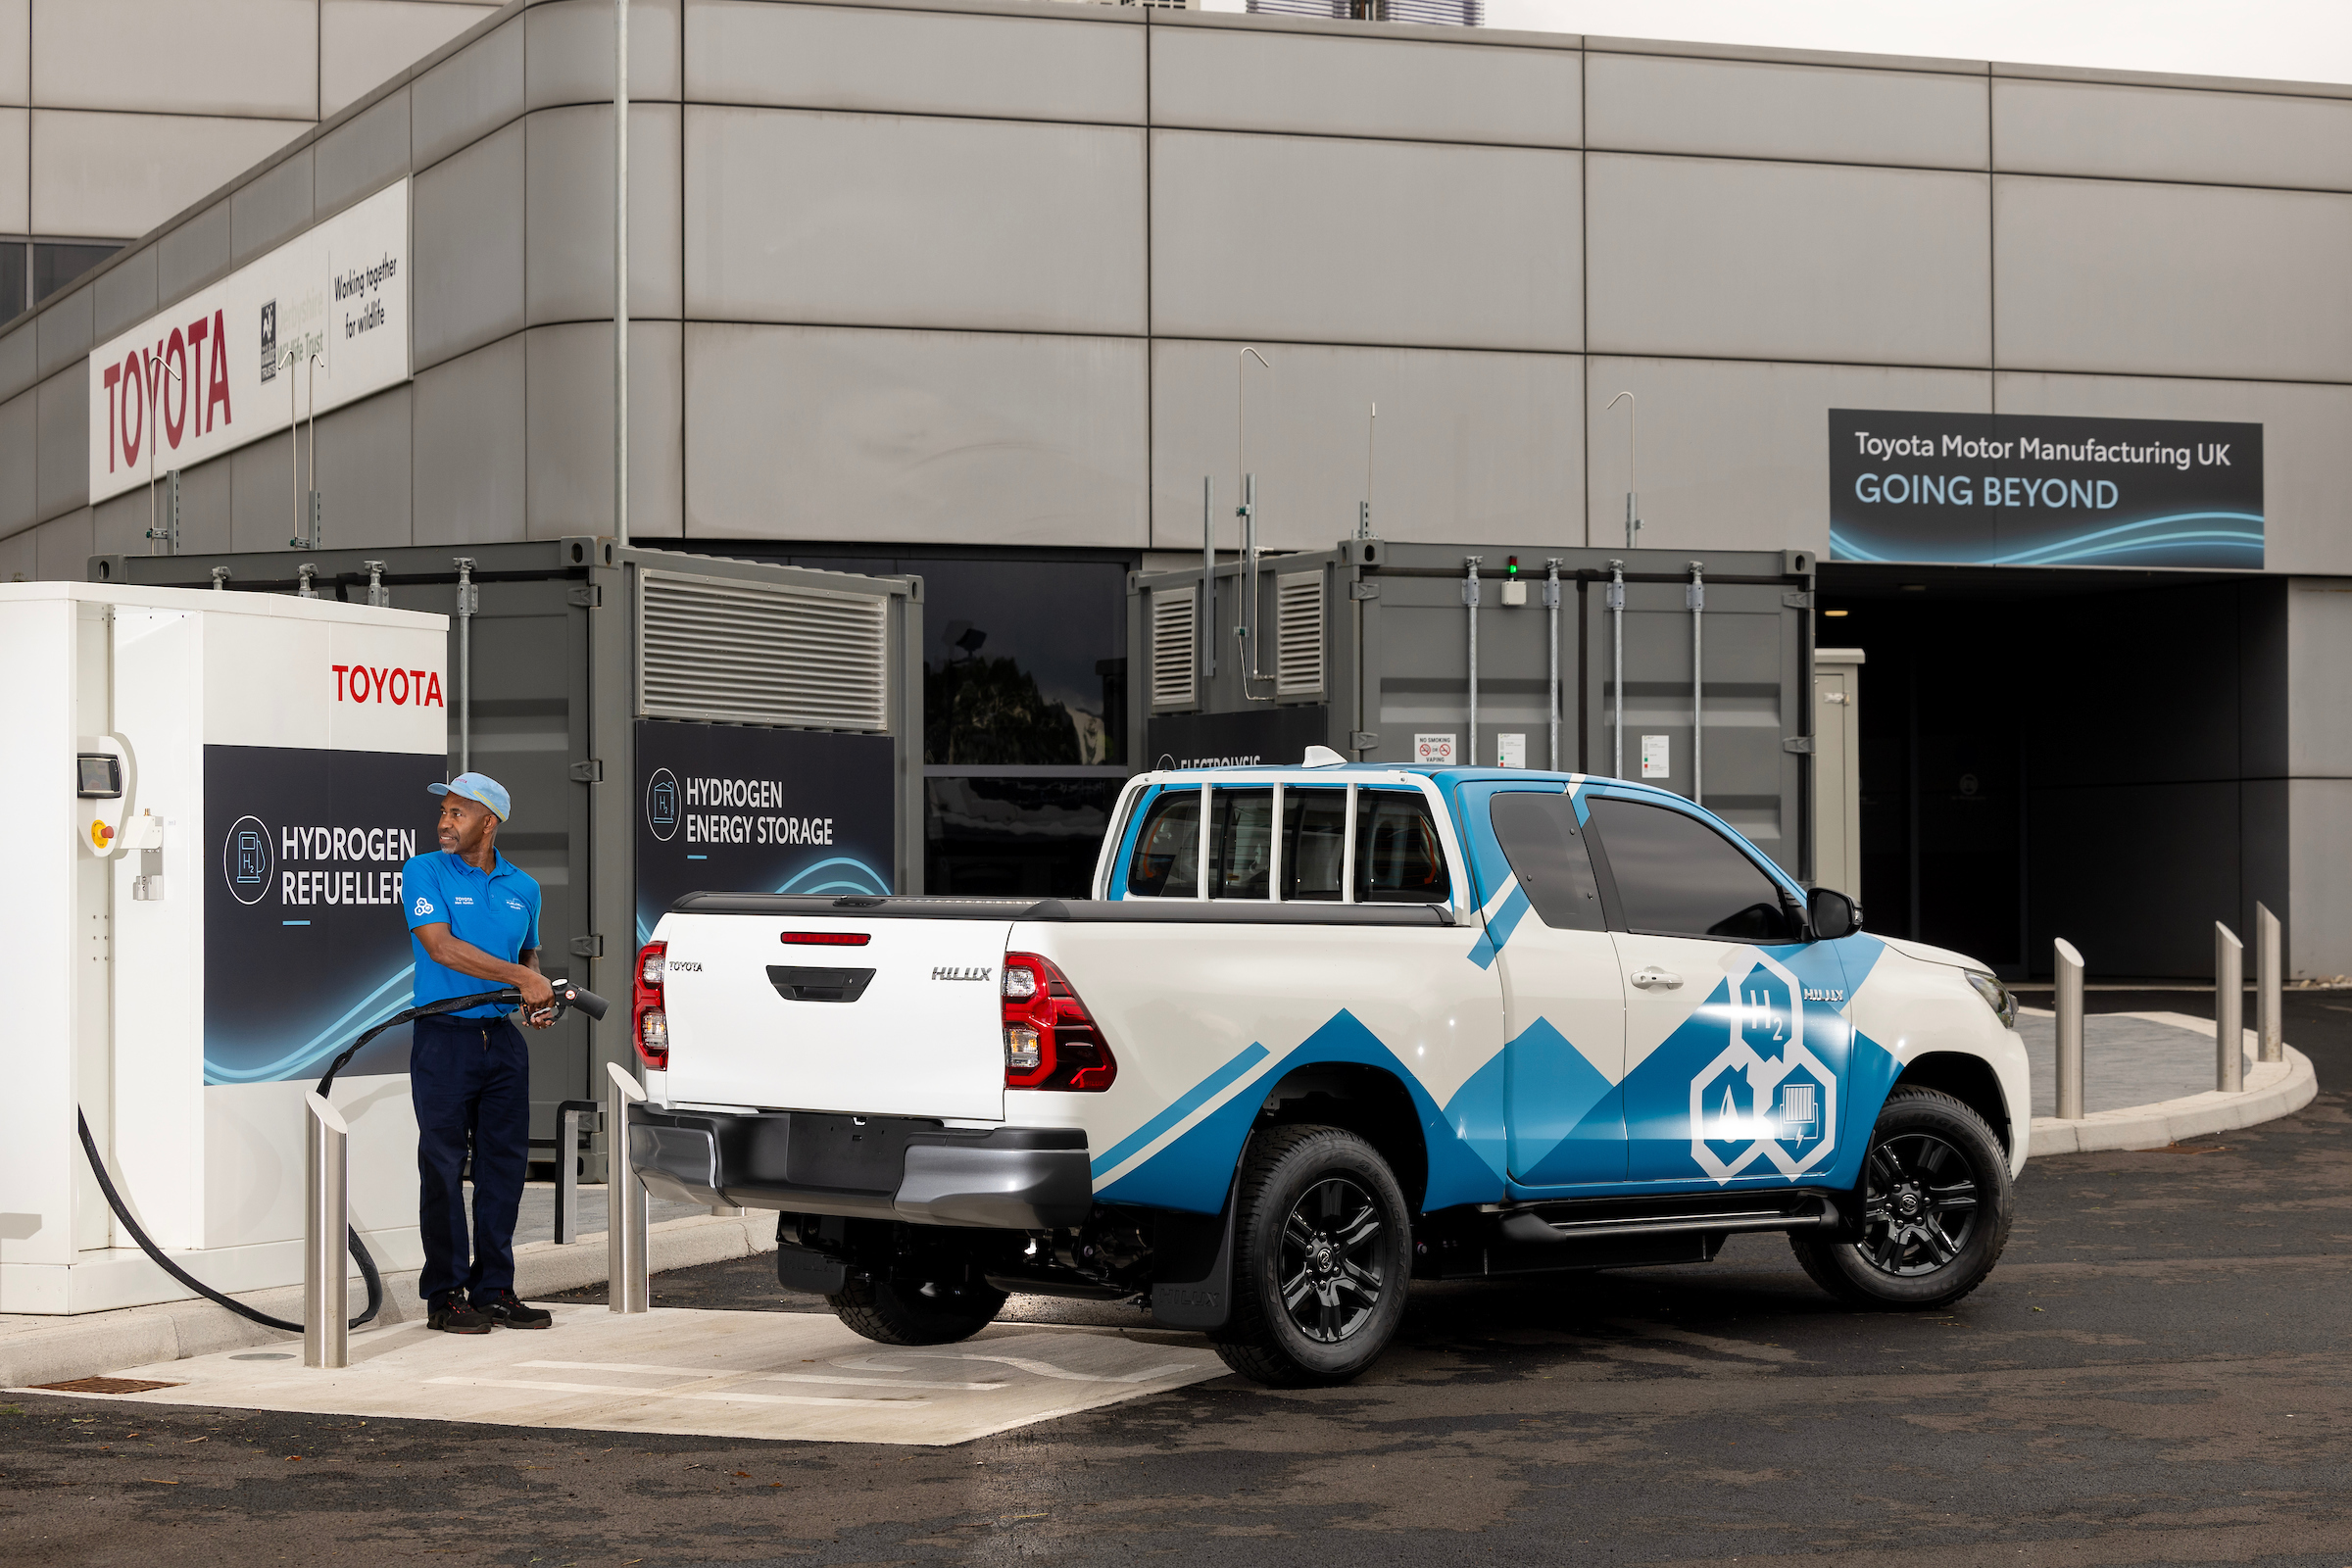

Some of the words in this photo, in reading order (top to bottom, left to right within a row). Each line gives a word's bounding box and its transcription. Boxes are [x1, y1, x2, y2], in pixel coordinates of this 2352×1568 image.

[334, 270, 364, 302] Working
[367, 252, 397, 291] together
[346, 313, 356, 340] for
[358, 298, 385, 334] wildlife
[305, 329, 323, 359] Trust
[104, 309, 231, 473] TOYOTA
[1855, 432, 1935, 461] Toyota
[1942, 435, 2013, 460] Motor
[2020, 437, 2191, 470] Manufacturing
[2198, 443, 2231, 466] UK
[1855, 473, 1974, 505] GOING
[1984, 476, 2119, 509] BEYOND
[332, 665, 444, 708] TOYOTA
[686, 777, 783, 808] HYDROGEN
[282, 826, 416, 861] HYDROGEN
[687, 814, 754, 844] ENERGY
[757, 816, 833, 845] STORAGE
[282, 871, 403, 905] REFUELLER
[669, 961, 703, 971] TOYOTA
[932, 967, 992, 981] HILUX
[1803, 988, 1843, 1001] HILUX
